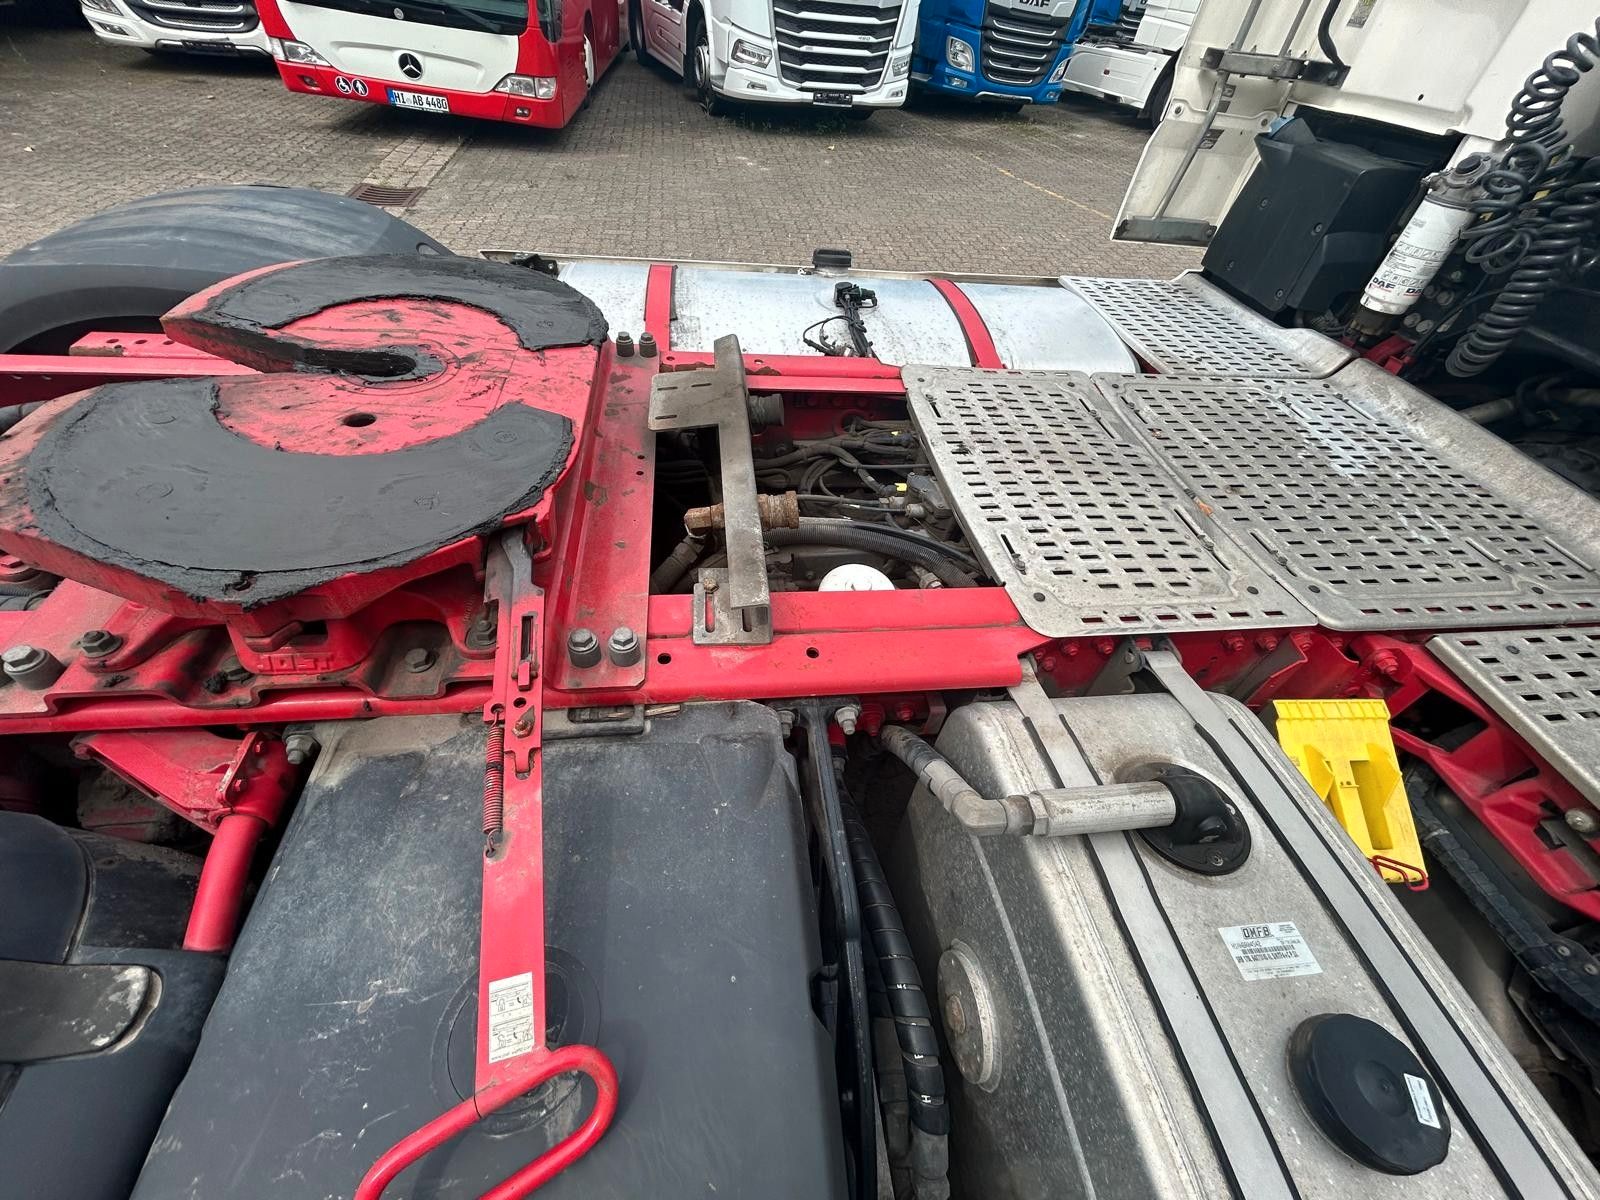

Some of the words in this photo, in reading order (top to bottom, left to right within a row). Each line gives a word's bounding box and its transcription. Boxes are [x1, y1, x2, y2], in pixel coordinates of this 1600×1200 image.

[393, 92, 406, 104] HI
[412, 95, 424, 106] AB
[425, 97, 448, 109] 4480
[1372, 277, 1396, 289] DAF
